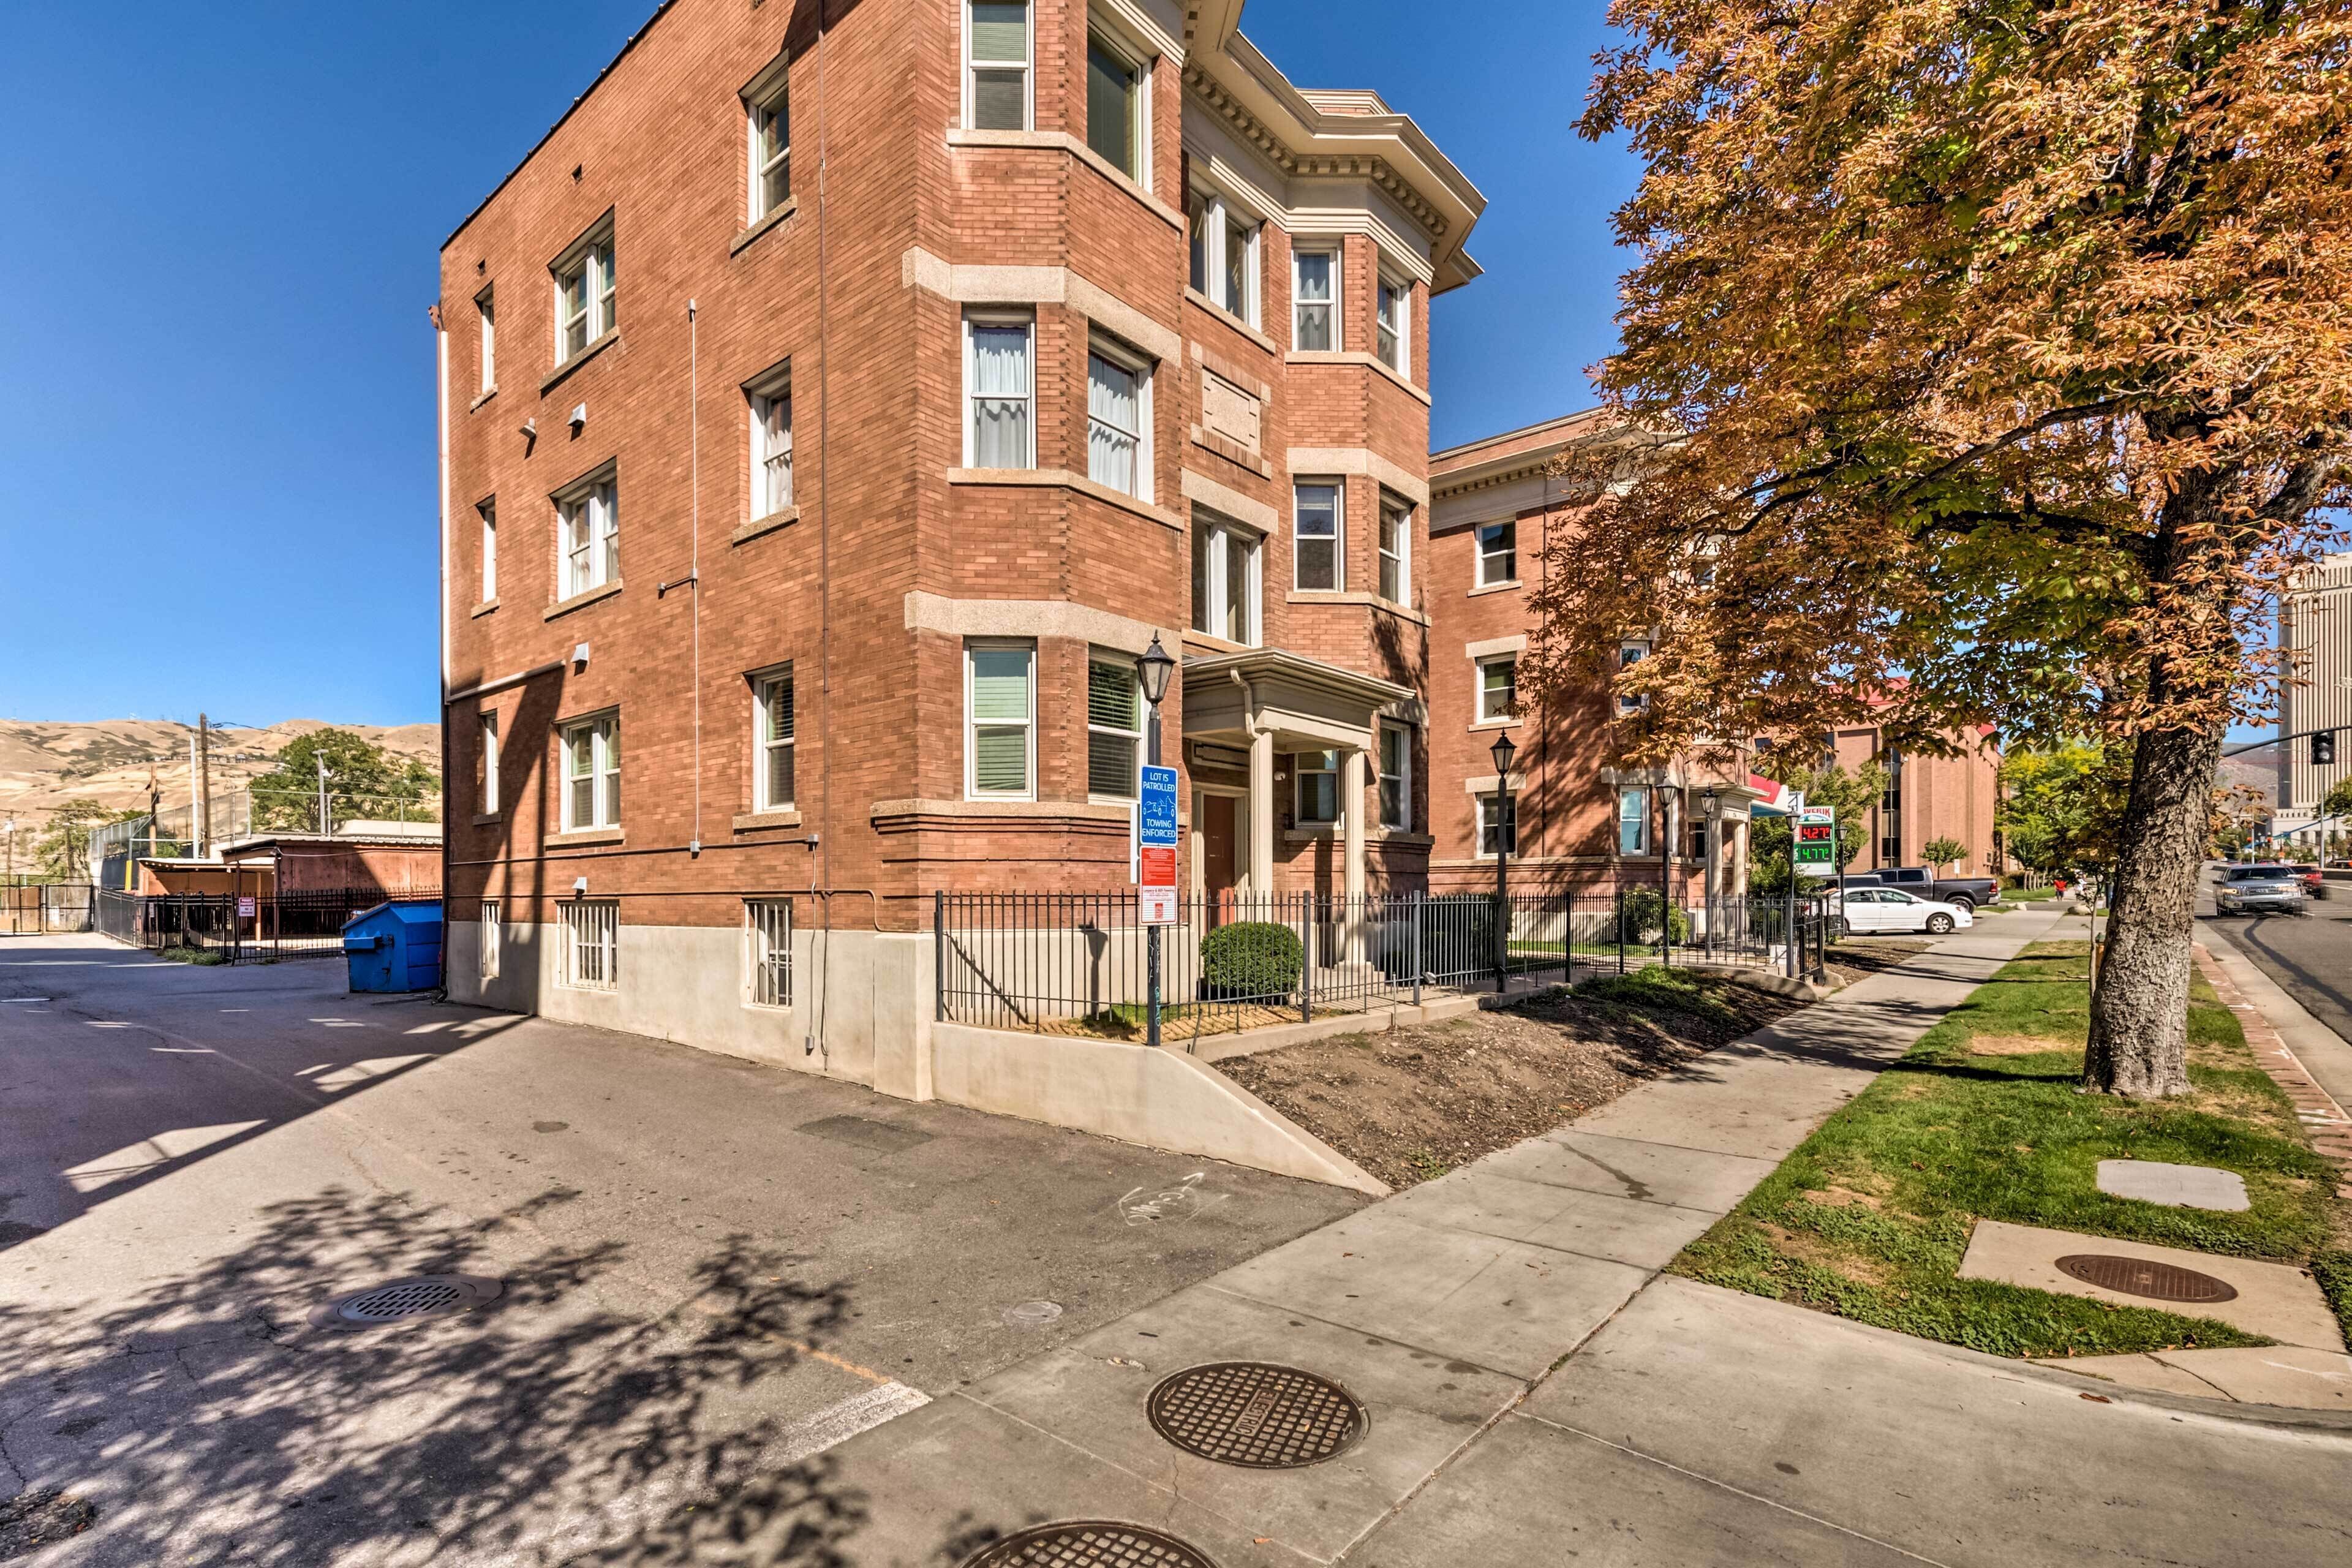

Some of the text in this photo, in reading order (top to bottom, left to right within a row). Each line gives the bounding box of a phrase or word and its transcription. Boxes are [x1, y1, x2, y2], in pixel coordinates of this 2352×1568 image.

[1150, 772, 1162, 781] LOT
[1143, 782, 1175, 792] PATROLLED
[1803, 807, 1831, 818] VERIK
[1147, 819, 1172, 828] TOWING
[1142, 828, 1175, 838] ENFORCED
[1235, 1390, 1276, 1434] ELECTRIC
